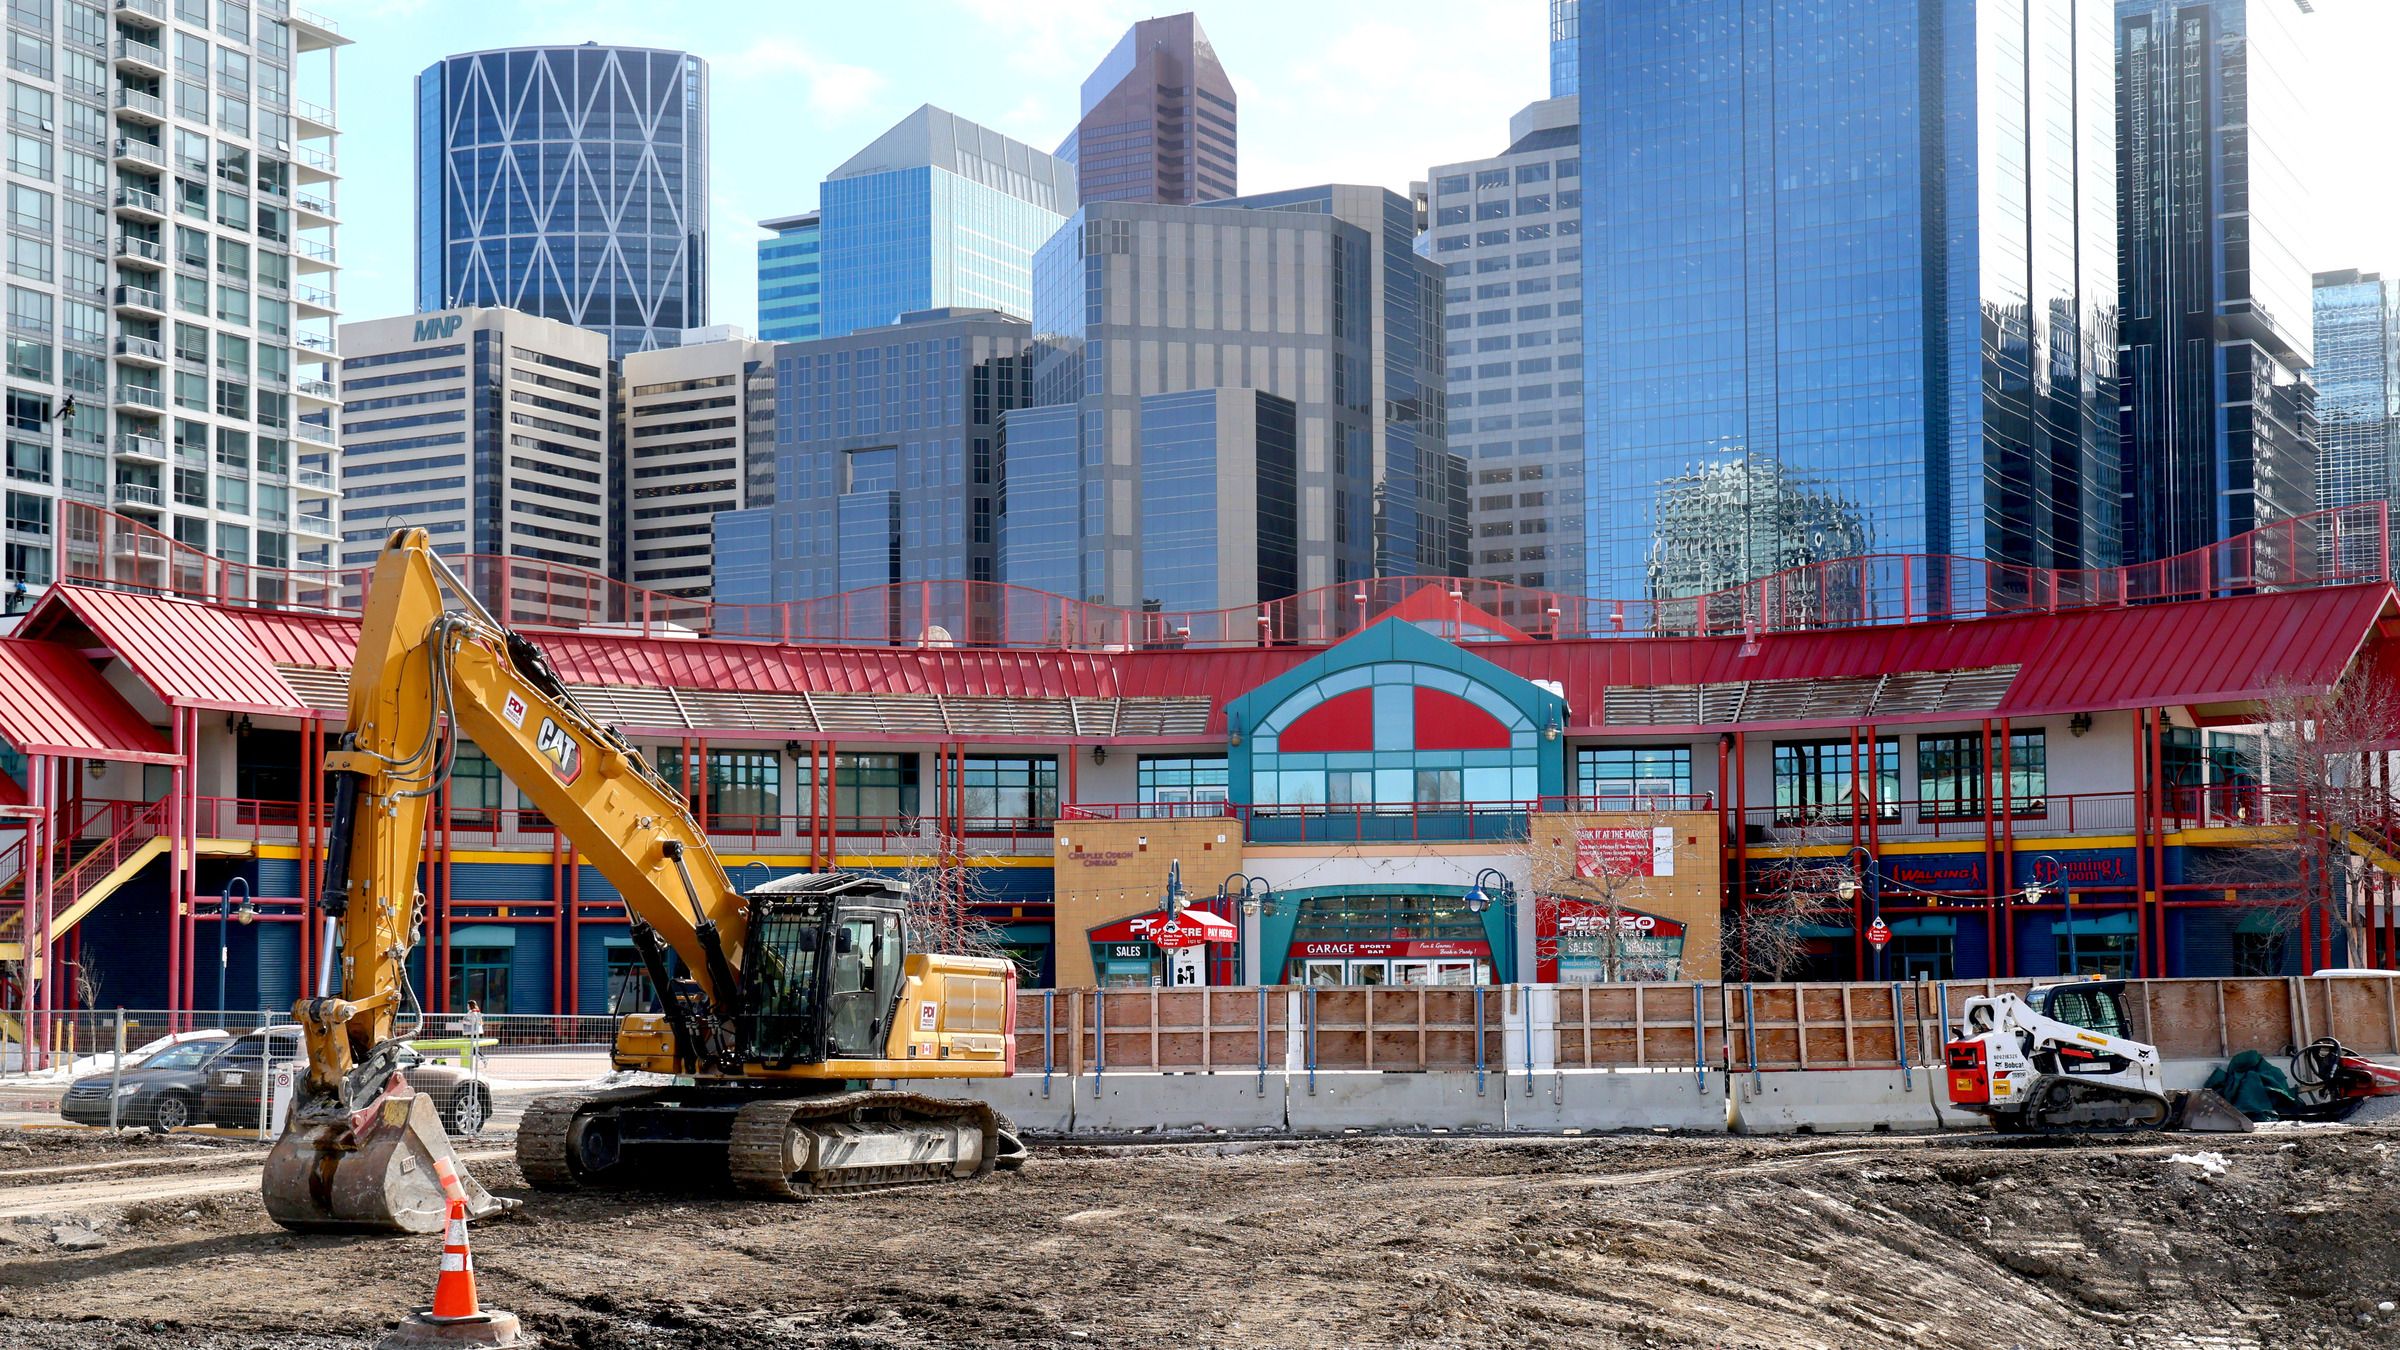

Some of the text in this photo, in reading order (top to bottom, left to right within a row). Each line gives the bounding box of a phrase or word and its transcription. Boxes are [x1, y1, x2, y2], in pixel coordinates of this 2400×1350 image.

[413, 315, 463, 342] MNP
[508, 696, 523, 716] PDI
[537, 717, 577, 771] CAT
[1602, 830, 1610, 839] AT
[1611, 830, 1624, 839] THE
[1068, 851, 1133, 860] CINEPLEX ODEON
[1901, 868, 1969, 881] WALKING
[883, 916, 895, 928] 340
[1207, 928, 1233, 938] PAY HERE
[1116, 946, 1141, 957] SALES
[1307, 943, 1355, 954] GARAGE
[1568, 942, 1662, 953] SALES RENTALS
[923, 1006, 935, 1018] PDI
